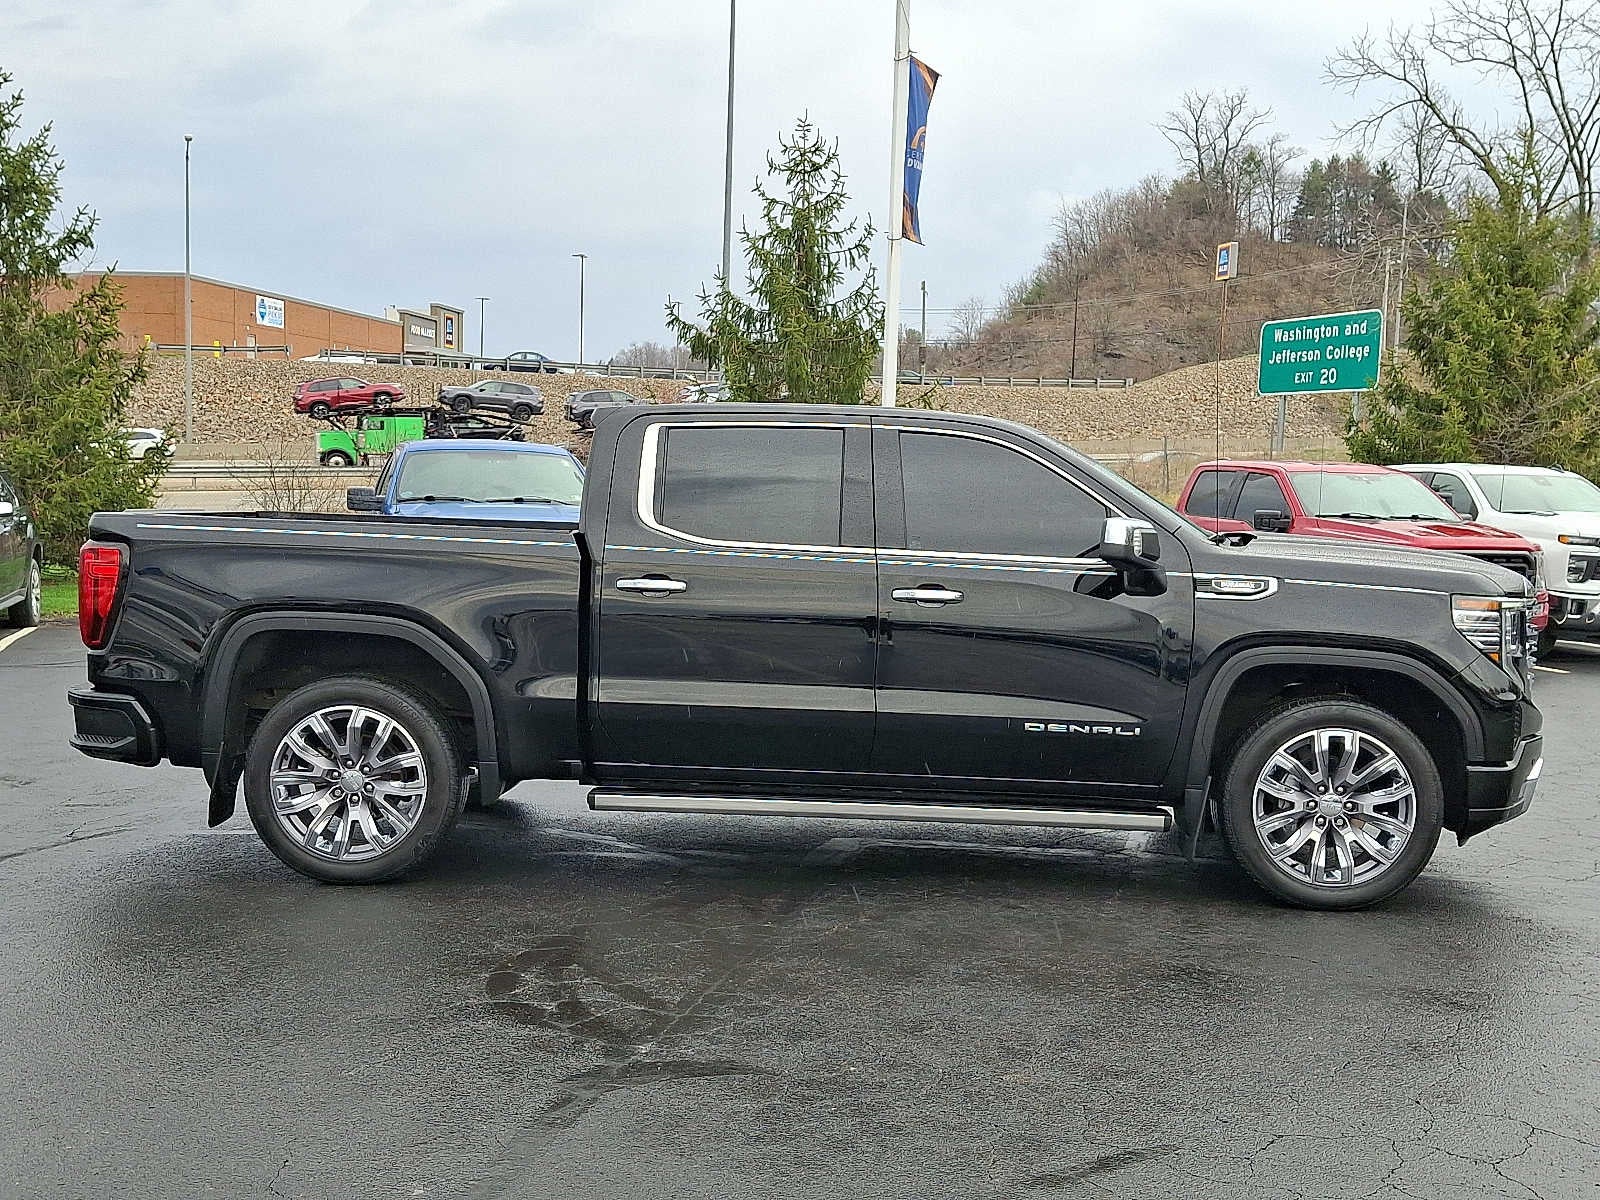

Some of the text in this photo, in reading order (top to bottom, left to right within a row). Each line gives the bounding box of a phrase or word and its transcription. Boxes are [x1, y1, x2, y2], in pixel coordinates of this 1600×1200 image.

[1274, 320, 1368, 343] Washington and
[1269, 345, 1370, 365] Jefferson College
[1294, 368, 1337, 385] EXIT 20
[1024, 722, 1140, 736] DENALI
